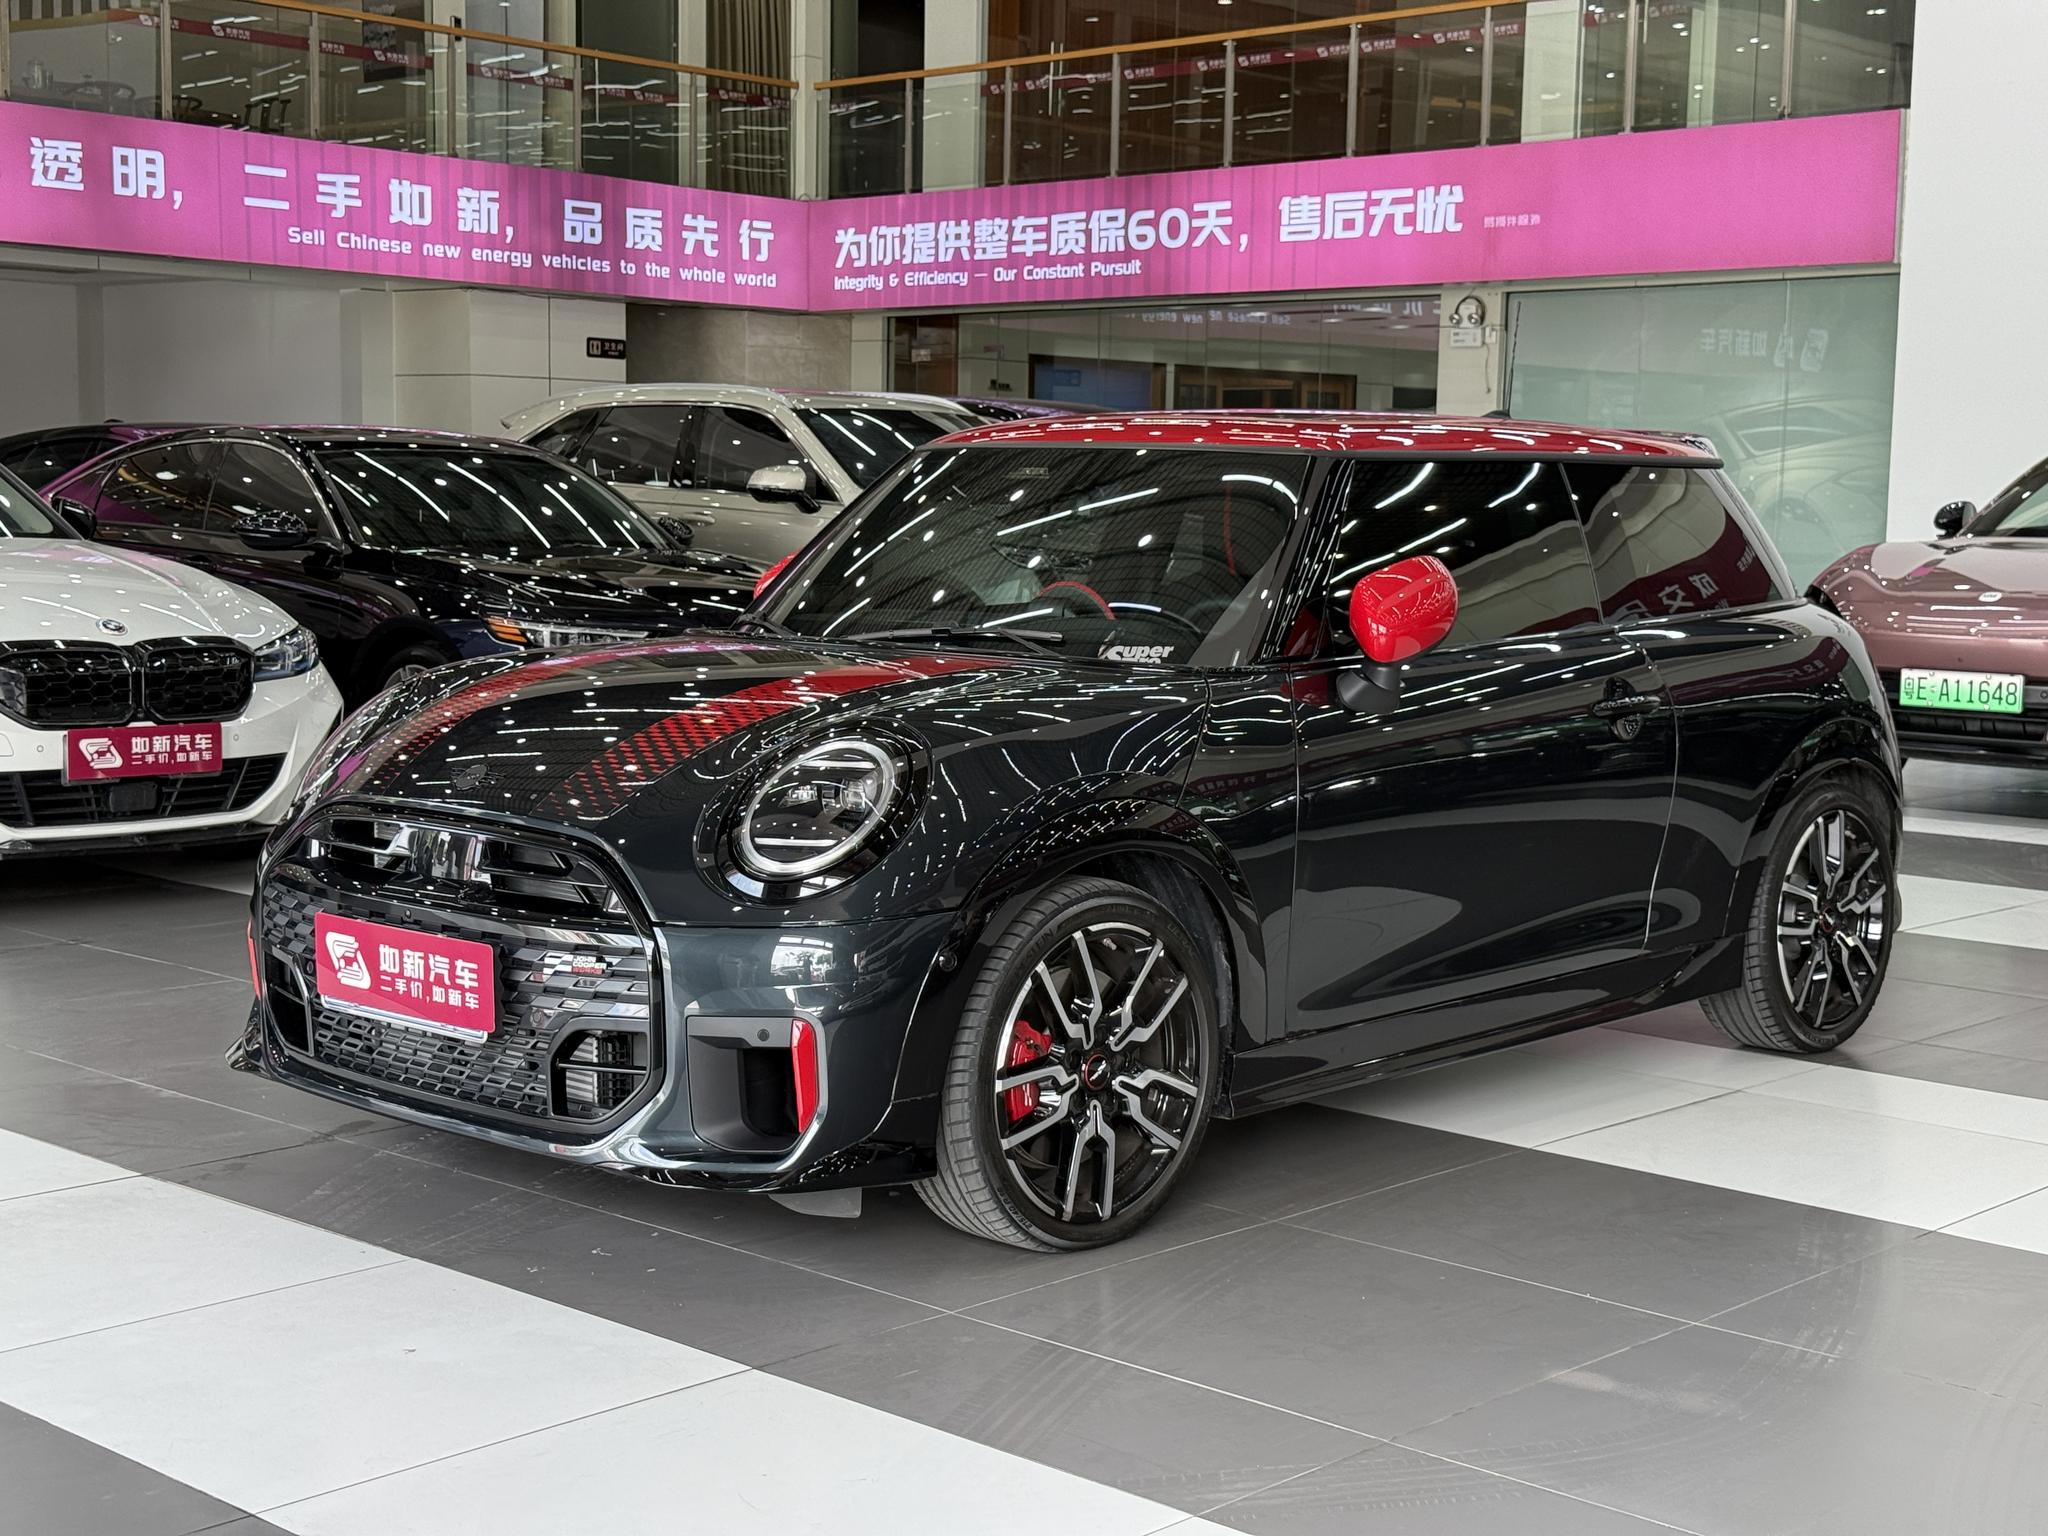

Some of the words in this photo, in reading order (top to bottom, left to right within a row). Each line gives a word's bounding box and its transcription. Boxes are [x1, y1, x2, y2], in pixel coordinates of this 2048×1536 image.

[287, 226, 326, 246] Sell
[336, 231, 412, 255] Chinese
[422, 242, 462, 259] new
[471, 247, 533, 269] energy
[541, 252, 611, 274] vehicles
[619, 258, 637, 275] to
[644, 261, 671, 279] the
[679, 266, 726, 284] whole
[733, 270, 777, 288] world
[834, 272, 884, 293] Integrity
[888, 272, 900, 288] &
[903, 269, 969, 287] Efficiency
[993, 266, 1018, 283] Our
[1022, 262, 1085, 281] Constant
[1090, 258, 1142, 277] Pursuit
[131, 733, 213, 754] 如新汽车
[378, 943, 480, 990] 如新汽车
